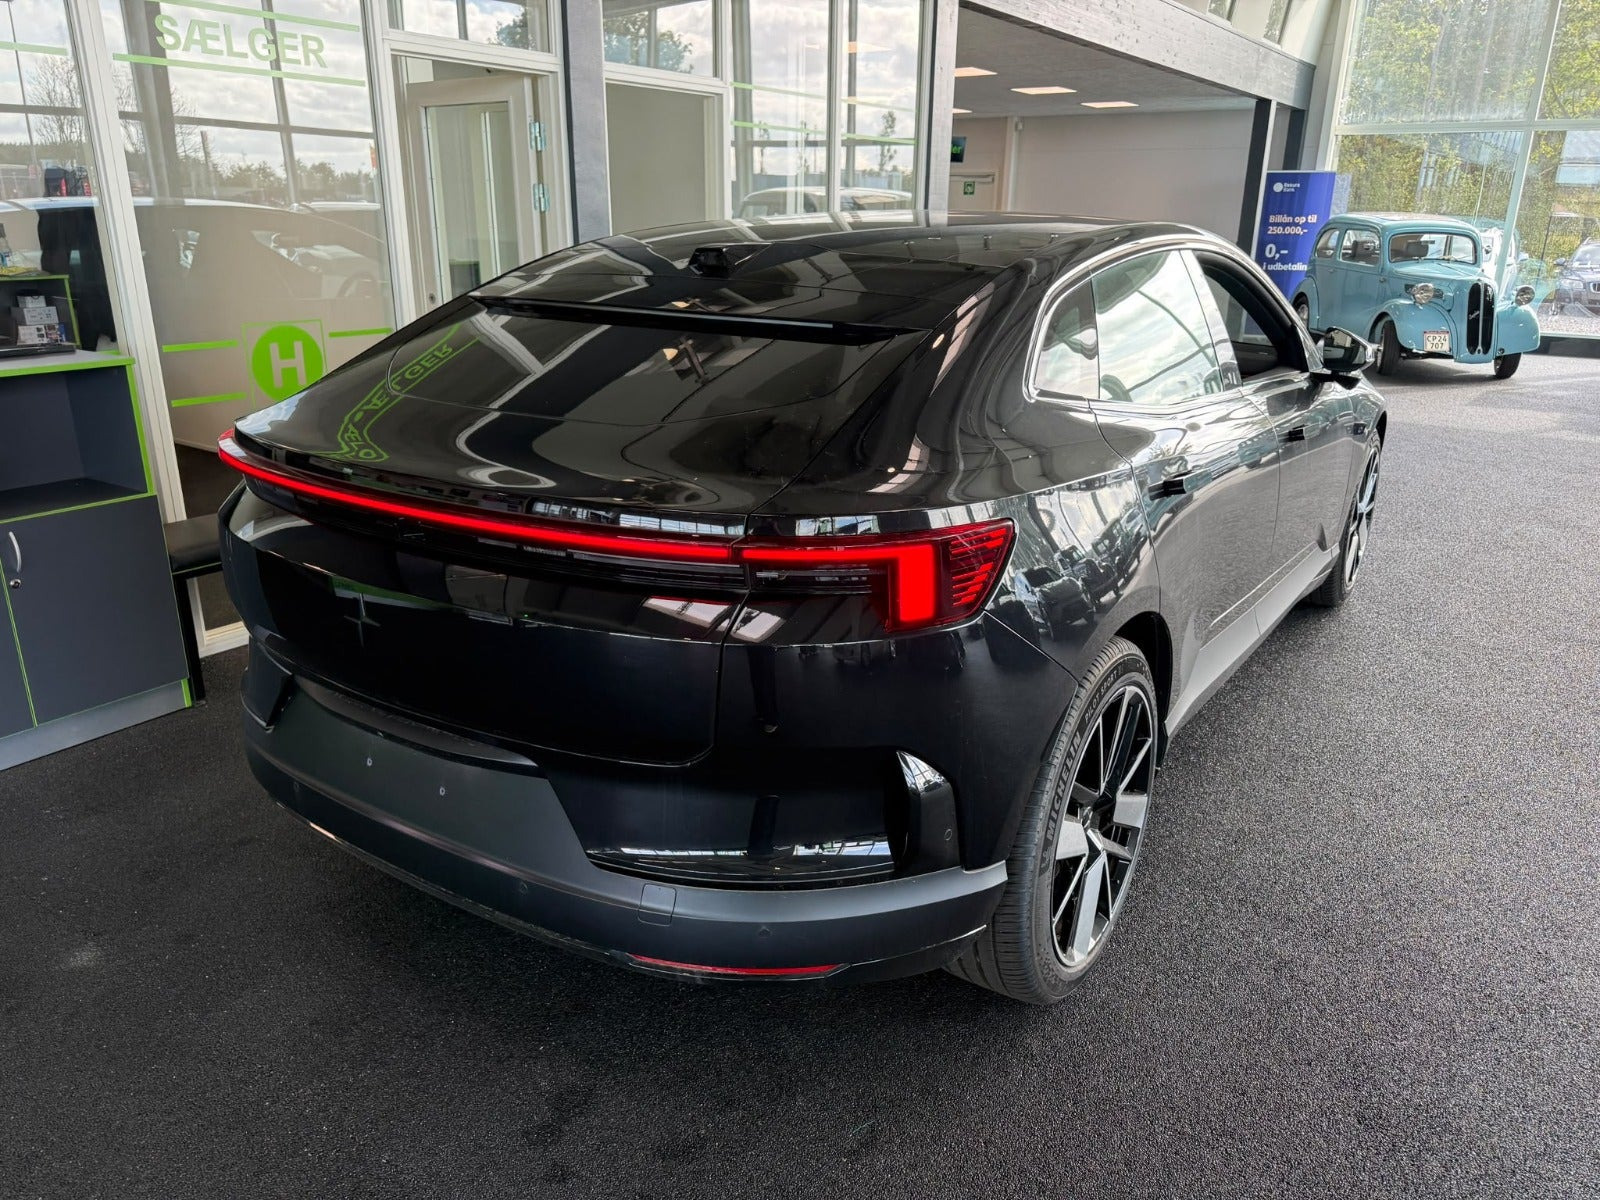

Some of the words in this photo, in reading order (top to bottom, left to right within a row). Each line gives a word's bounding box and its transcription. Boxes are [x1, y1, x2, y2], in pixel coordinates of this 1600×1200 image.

[154, 14, 328, 68] SÆLGER
[1269, 214, 1293, 223] Billån
[1294, 216, 1306, 225] op
[1307, 214, 1318, 223] til
[1267, 226, 1308, 236] 250.000,-
[1265, 243, 1289, 260] 0,-
[1267, 262, 1308, 271] udbetalin
[1430, 342, 1444, 350] 707
[269, 340, 308, 389] H
[1046, 730, 1082, 841] MICHELIN
